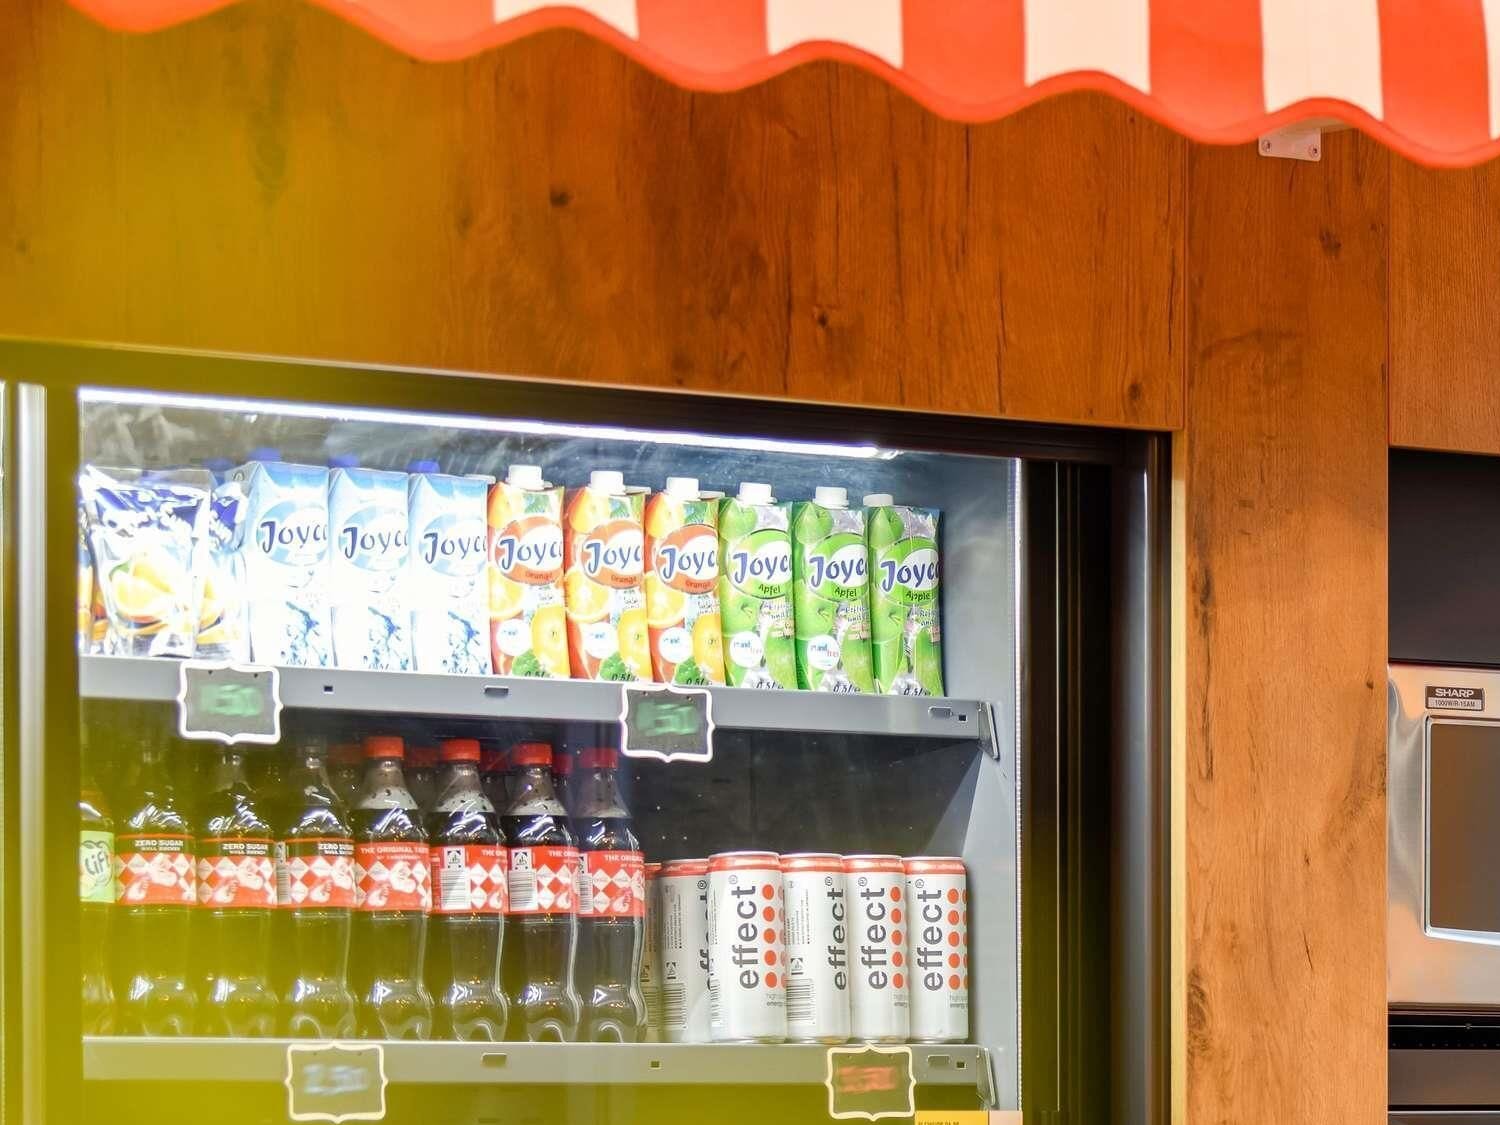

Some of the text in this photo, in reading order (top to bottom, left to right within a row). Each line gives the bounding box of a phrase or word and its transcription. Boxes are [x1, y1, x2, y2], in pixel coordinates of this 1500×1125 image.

[758, 584, 781, 594] Apfel
[834, 587, 857, 597] Apfel
[1435, 688, 1474, 697] SHARP
[134, 839, 184, 847] ZERO SUGAR
[222, 843, 245, 851] ZERO
[317, 843, 338, 851] ZERO
[731, 885, 760, 989] effect
[826, 887, 847, 991] effect
[860, 885, 888, 990] effect
[916, 889, 944, 991] effect
